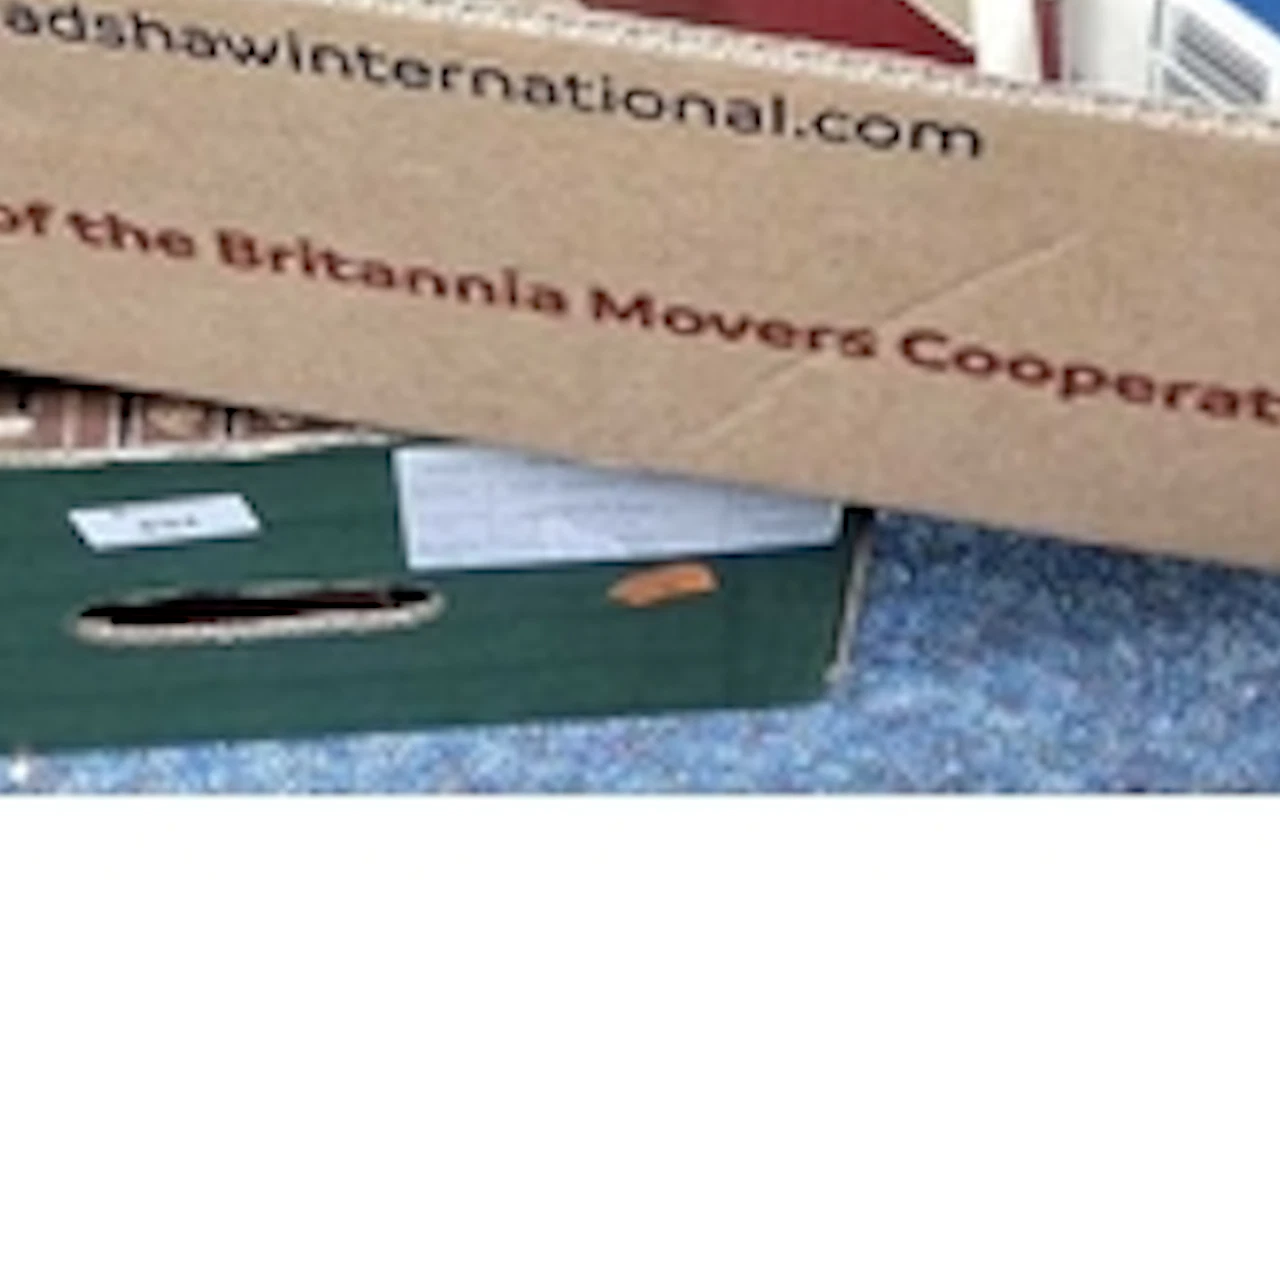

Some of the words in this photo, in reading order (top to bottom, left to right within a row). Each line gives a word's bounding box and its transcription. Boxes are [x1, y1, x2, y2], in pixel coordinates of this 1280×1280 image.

[66, 205, 196, 262] the
[217, 226, 569, 318] Britannia
[588, 287, 879, 361] Movers
